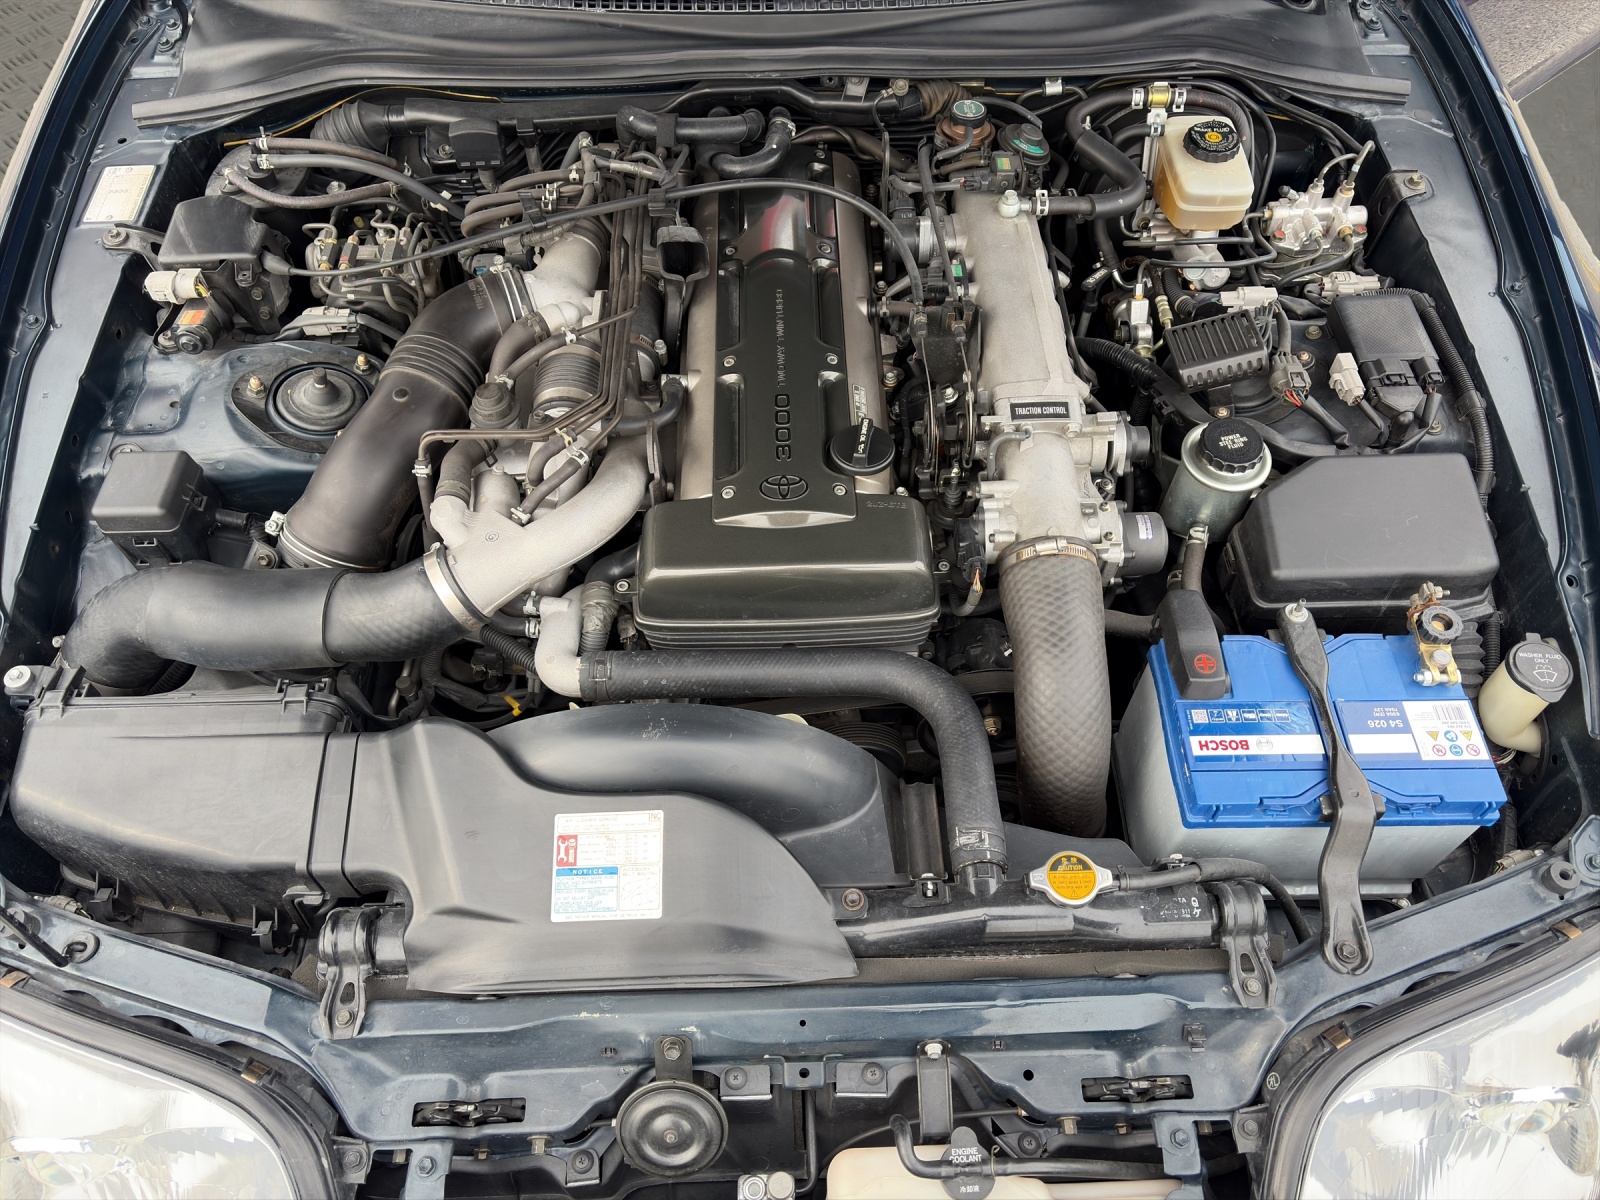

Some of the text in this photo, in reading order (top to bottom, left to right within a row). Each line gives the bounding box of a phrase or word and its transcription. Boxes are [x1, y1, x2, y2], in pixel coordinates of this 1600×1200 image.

[775, 288, 786, 387] TWO WAY TWIN TURBO
[1014, 406, 1068, 415] TRACTION CONTROL
[774, 393, 792, 462] 3000
[1220, 433, 1241, 442] POWER
[1227, 442, 1245, 450] FLUID
[1367, 719, 1404, 728] S4 026
[1198, 739, 1250, 751] BOSCH
[951, 1147, 979, 1156] ENGINE
[948, 1154, 982, 1164] COOLANT
